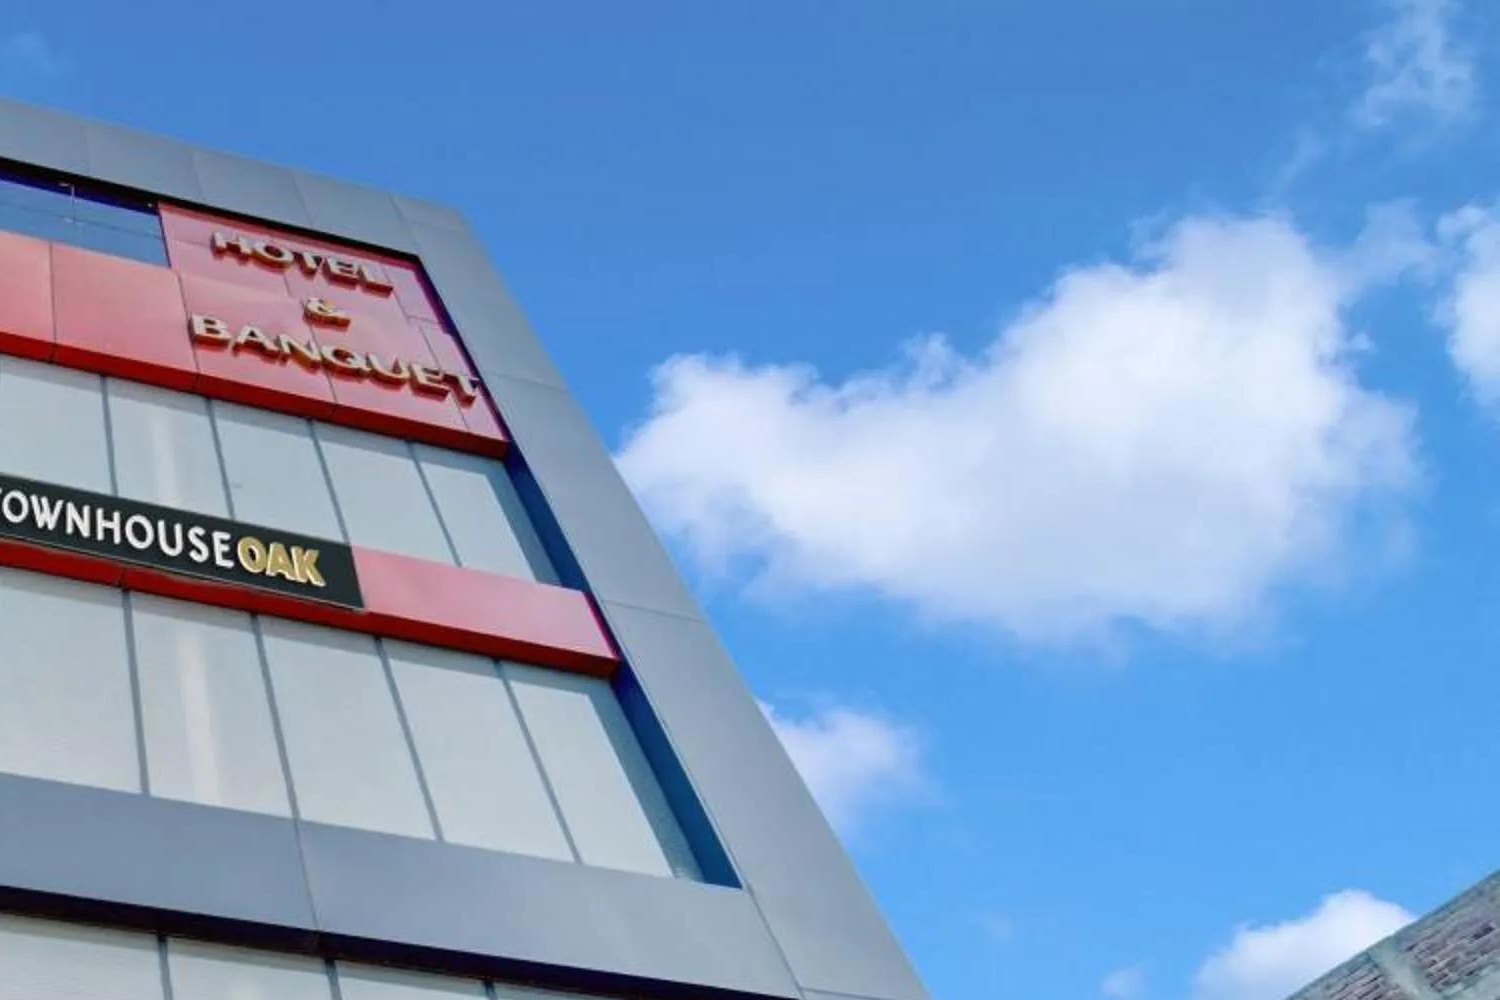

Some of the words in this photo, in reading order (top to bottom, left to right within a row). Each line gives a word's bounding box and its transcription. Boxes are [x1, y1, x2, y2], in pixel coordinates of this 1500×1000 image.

[211, 231, 393, 297] HOTEL
[303, 297, 351, 330] &
[189, 312, 479, 405] BANQUET
